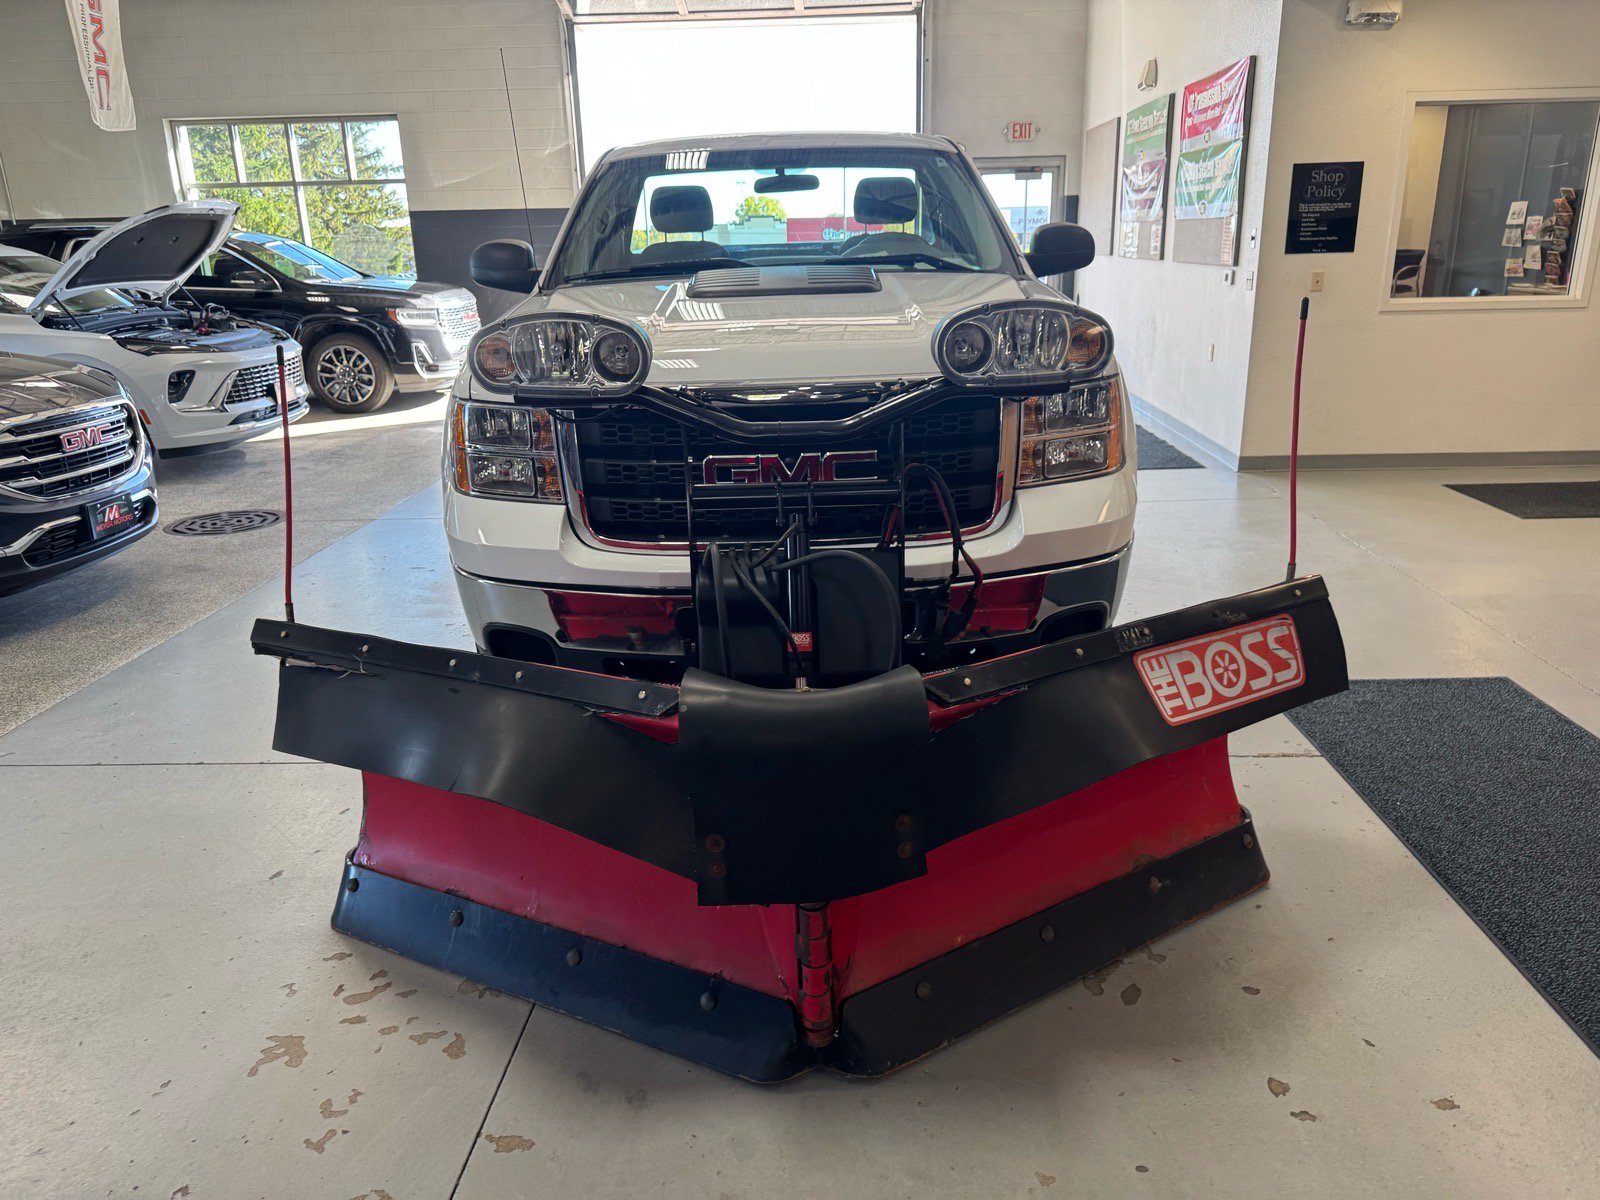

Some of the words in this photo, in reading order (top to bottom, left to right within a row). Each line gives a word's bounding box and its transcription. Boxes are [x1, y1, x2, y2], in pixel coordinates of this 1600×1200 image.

[80, 3, 92, 74] PROFESSIONAL
[1012, 123, 1032, 139] EXIT
[1311, 169, 1344, 185] Shop
[1307, 185, 1346, 200] Policy
[60, 423, 113, 451] GMC
[703, 450, 878, 484] GMC
[96, 519, 113, 532] MEYER
[113, 514, 134, 527] MOTORS
[1142, 655, 1184, 716] THE
[1165, 625, 1298, 711] BOSS
